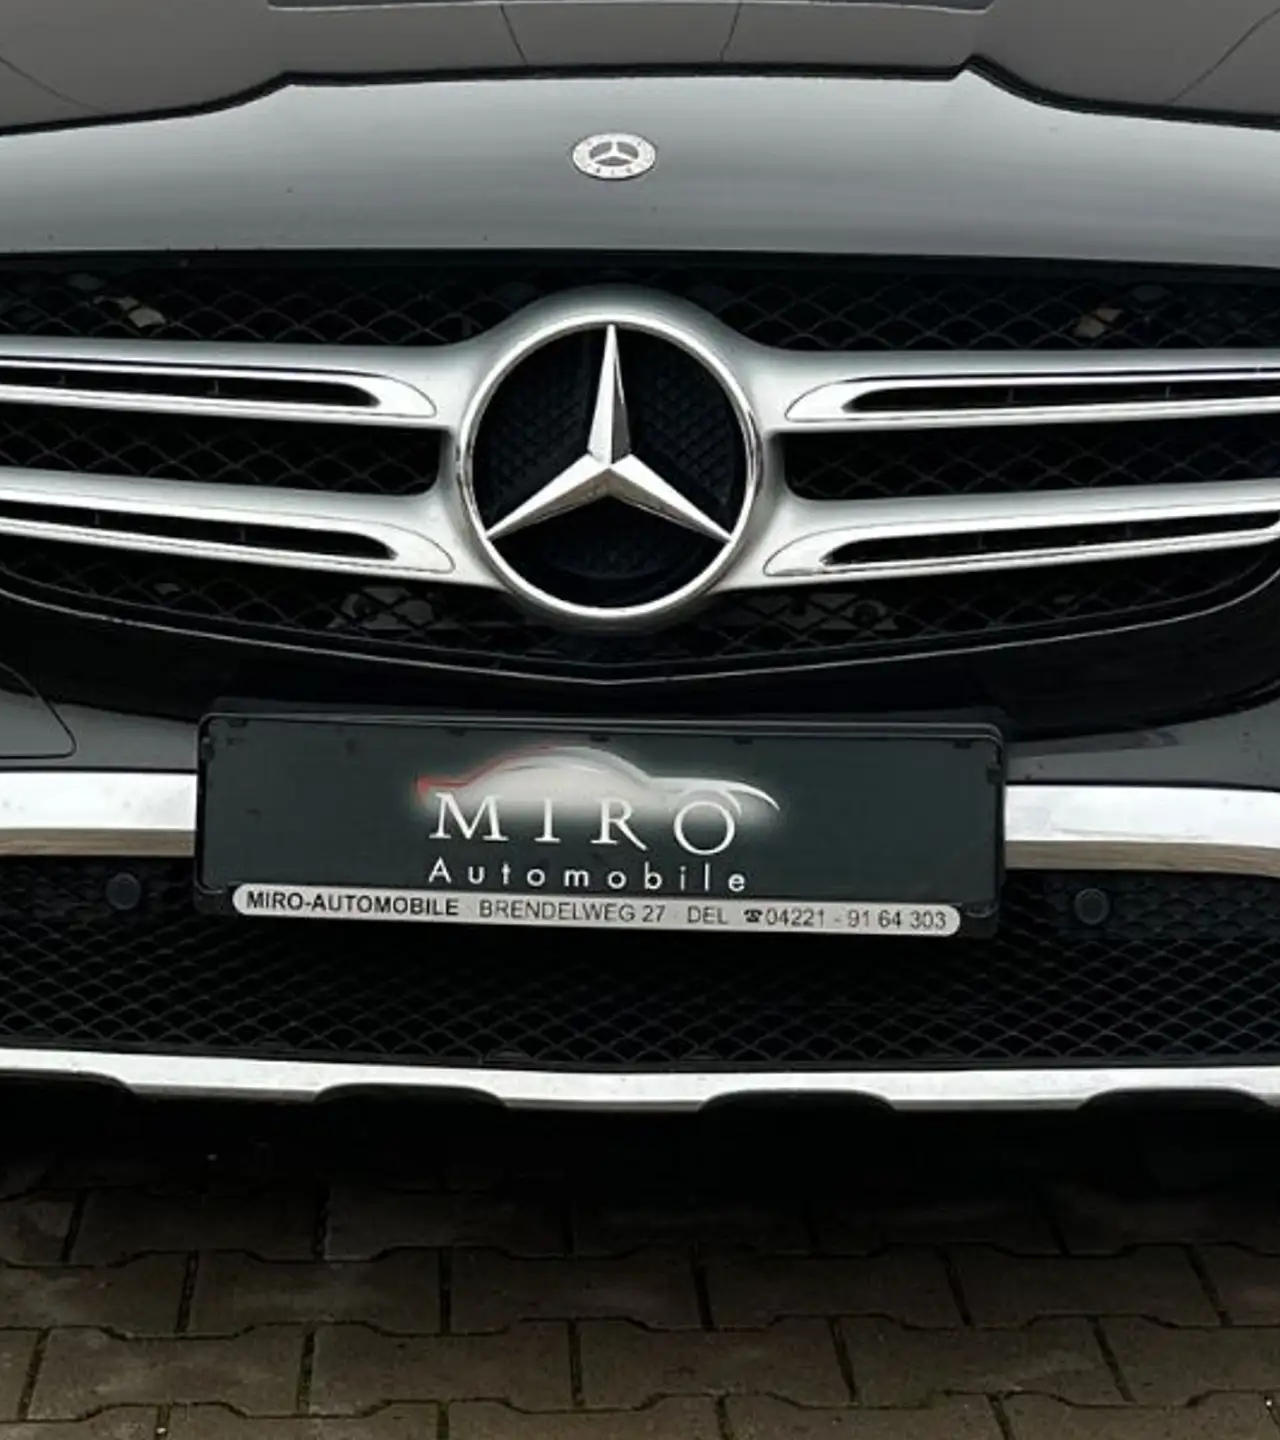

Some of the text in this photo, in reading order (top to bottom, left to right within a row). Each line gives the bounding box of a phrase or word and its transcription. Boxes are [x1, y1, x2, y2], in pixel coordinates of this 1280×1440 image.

[428, 791, 735, 855] MIRO
[429, 858, 746, 893] Automobile
[245, 891, 459, 916] MIRO-AUTOMOBILE
[479, 899, 636, 924] BRENDELWEG
[641, 905, 666, 924] 27
[687, 905, 729, 926] DEL
[877, 912, 902, 930] 64
[909, 913, 947, 931] 303
